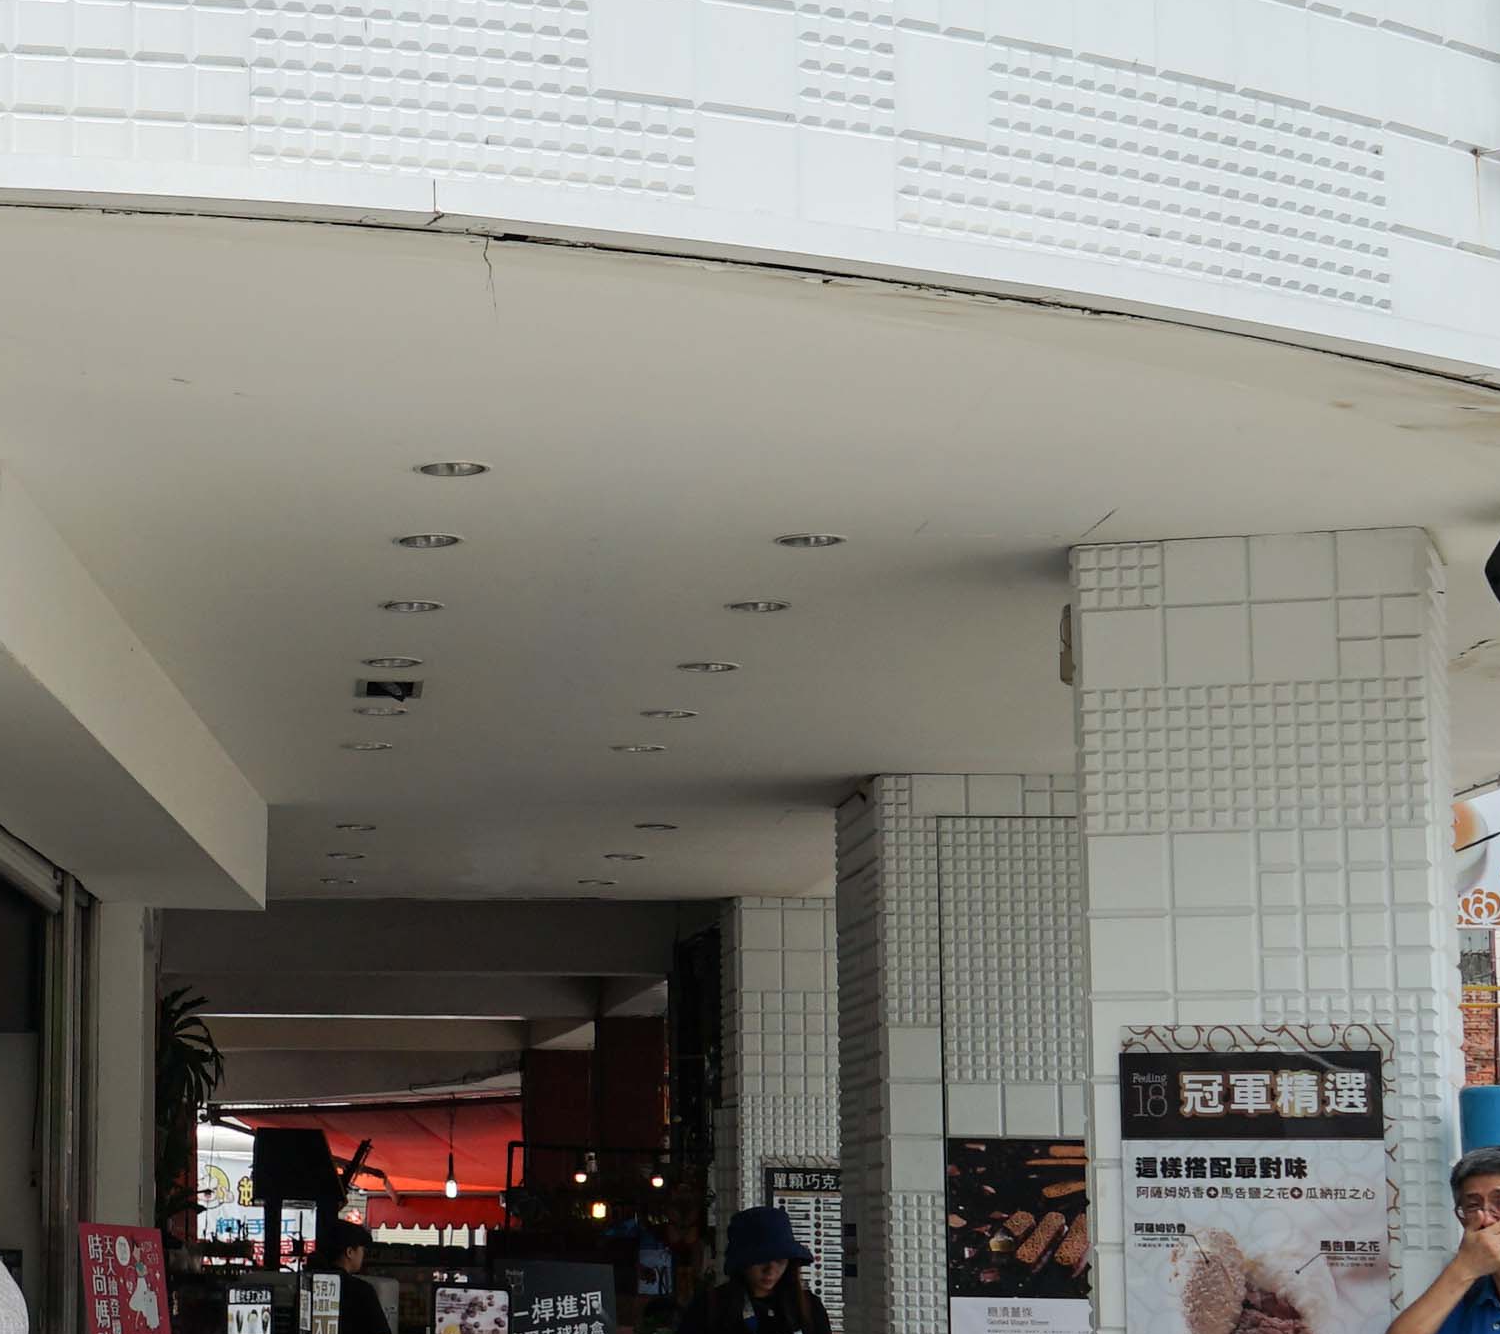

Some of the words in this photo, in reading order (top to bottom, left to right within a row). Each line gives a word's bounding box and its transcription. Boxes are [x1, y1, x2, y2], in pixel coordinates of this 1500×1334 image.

[1132, 1073, 1167, 1084] Feeling
[1132, 1084, 1168, 1117] 18
[1182, 1072, 1368, 1114] 冠軍精選
[1135, 1157, 1308, 1179] 這樣搭配最對味
[774, 1173, 840, 1189] 單顆巧克
[1136, 1187, 1204, 1199] 阿薩姆奶香
[1221, 1187, 1290, 1199] 馬告鹽之花
[1305, 1188, 1375, 1200] 瓜納拉之心
